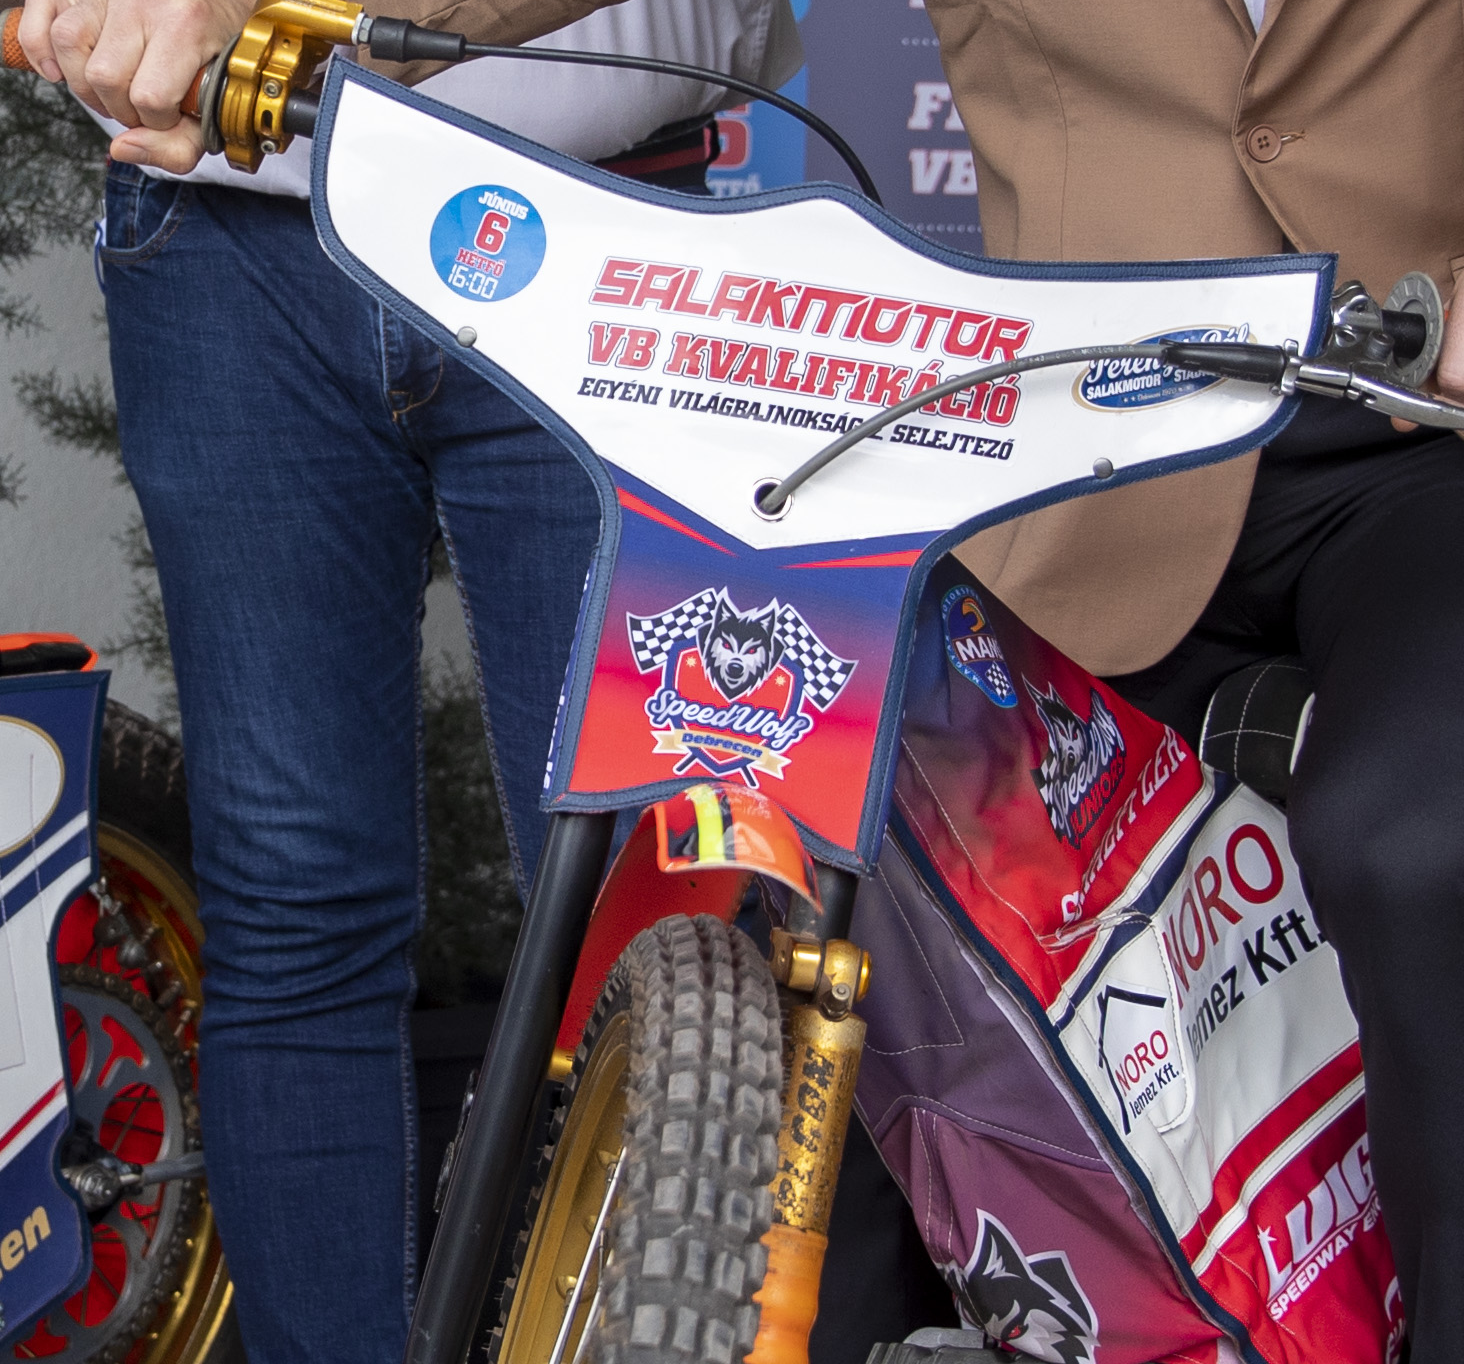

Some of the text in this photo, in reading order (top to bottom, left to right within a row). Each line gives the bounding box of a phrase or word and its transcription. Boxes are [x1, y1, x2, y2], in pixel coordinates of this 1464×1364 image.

[473, 209, 512, 255] 6
[478, 191, 529, 220] JÚNIUS
[448, 263, 499, 299] 16:00
[455, 246, 506, 278] HÉTFŐ
[590, 259, 1034, 362] SALAKMOTOR
[590, 323, 1020, 426] VB KVALIFIKÁCIÓ
[1086, 373, 1162, 400] SALAKMOTOR
[577, 377, 663, 405] EGYÉNI
[669, 389, 864, 436] VILÁGBAJNOKSÁG
[890, 423, 1016, 461] SELEJTEZŐ
[651, 690, 808, 749] SpeedWolf
[681, 732, 764, 758] Debrecen
[1162, 823, 1285, 1010] NORO
[1114, 1029, 1169, 1097] NORO
[1154, 1062, 1180, 1090] Kft.
[1257, 1132, 1375, 1302] LUIG
[1270, 1223, 1359, 1322] SPEEDWAY
